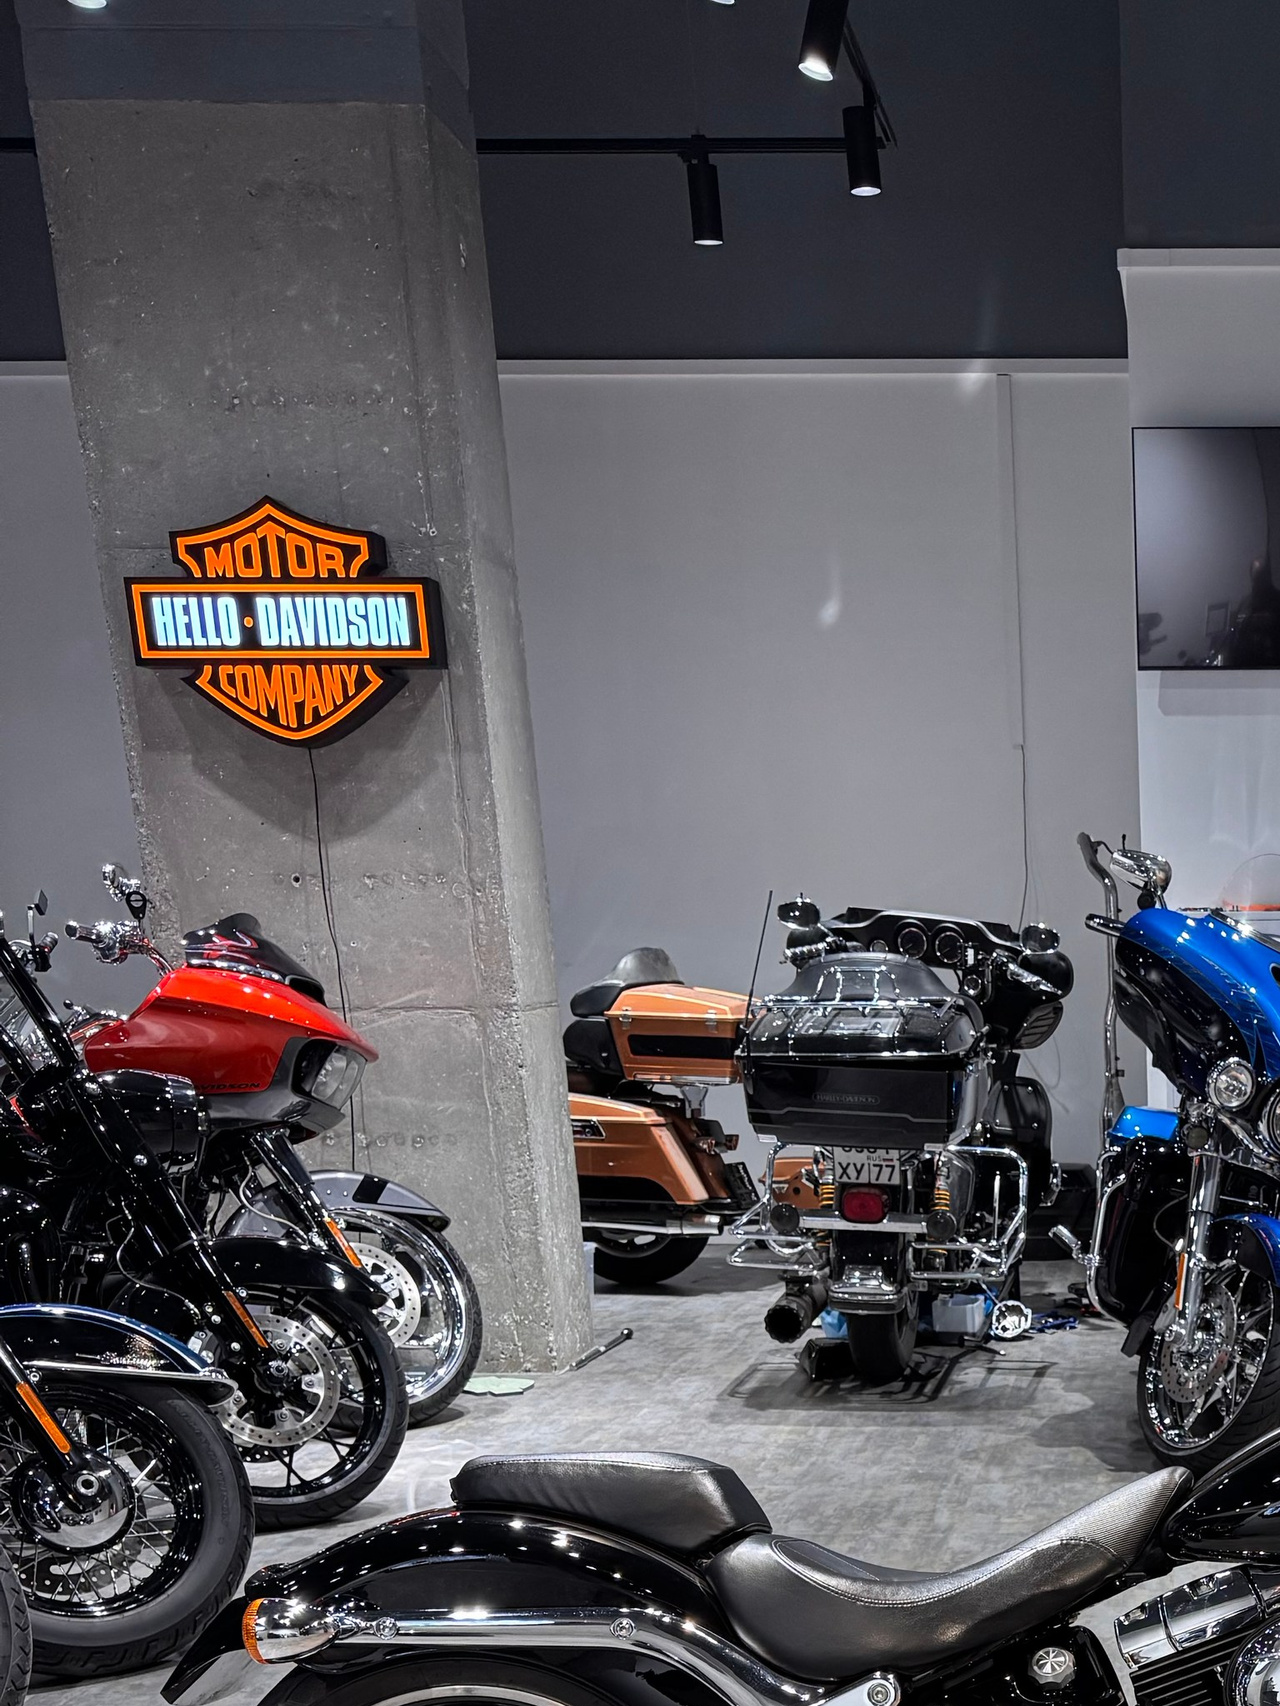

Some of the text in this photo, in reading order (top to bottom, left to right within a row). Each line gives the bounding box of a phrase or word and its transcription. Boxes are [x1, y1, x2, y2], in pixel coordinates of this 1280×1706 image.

[204, 521, 346, 578] MOTOR
[152, 597, 411, 647] HELLO DAVIDSON
[219, 664, 358, 728] COMPANY
[872, 1163, 896, 1182] 77
